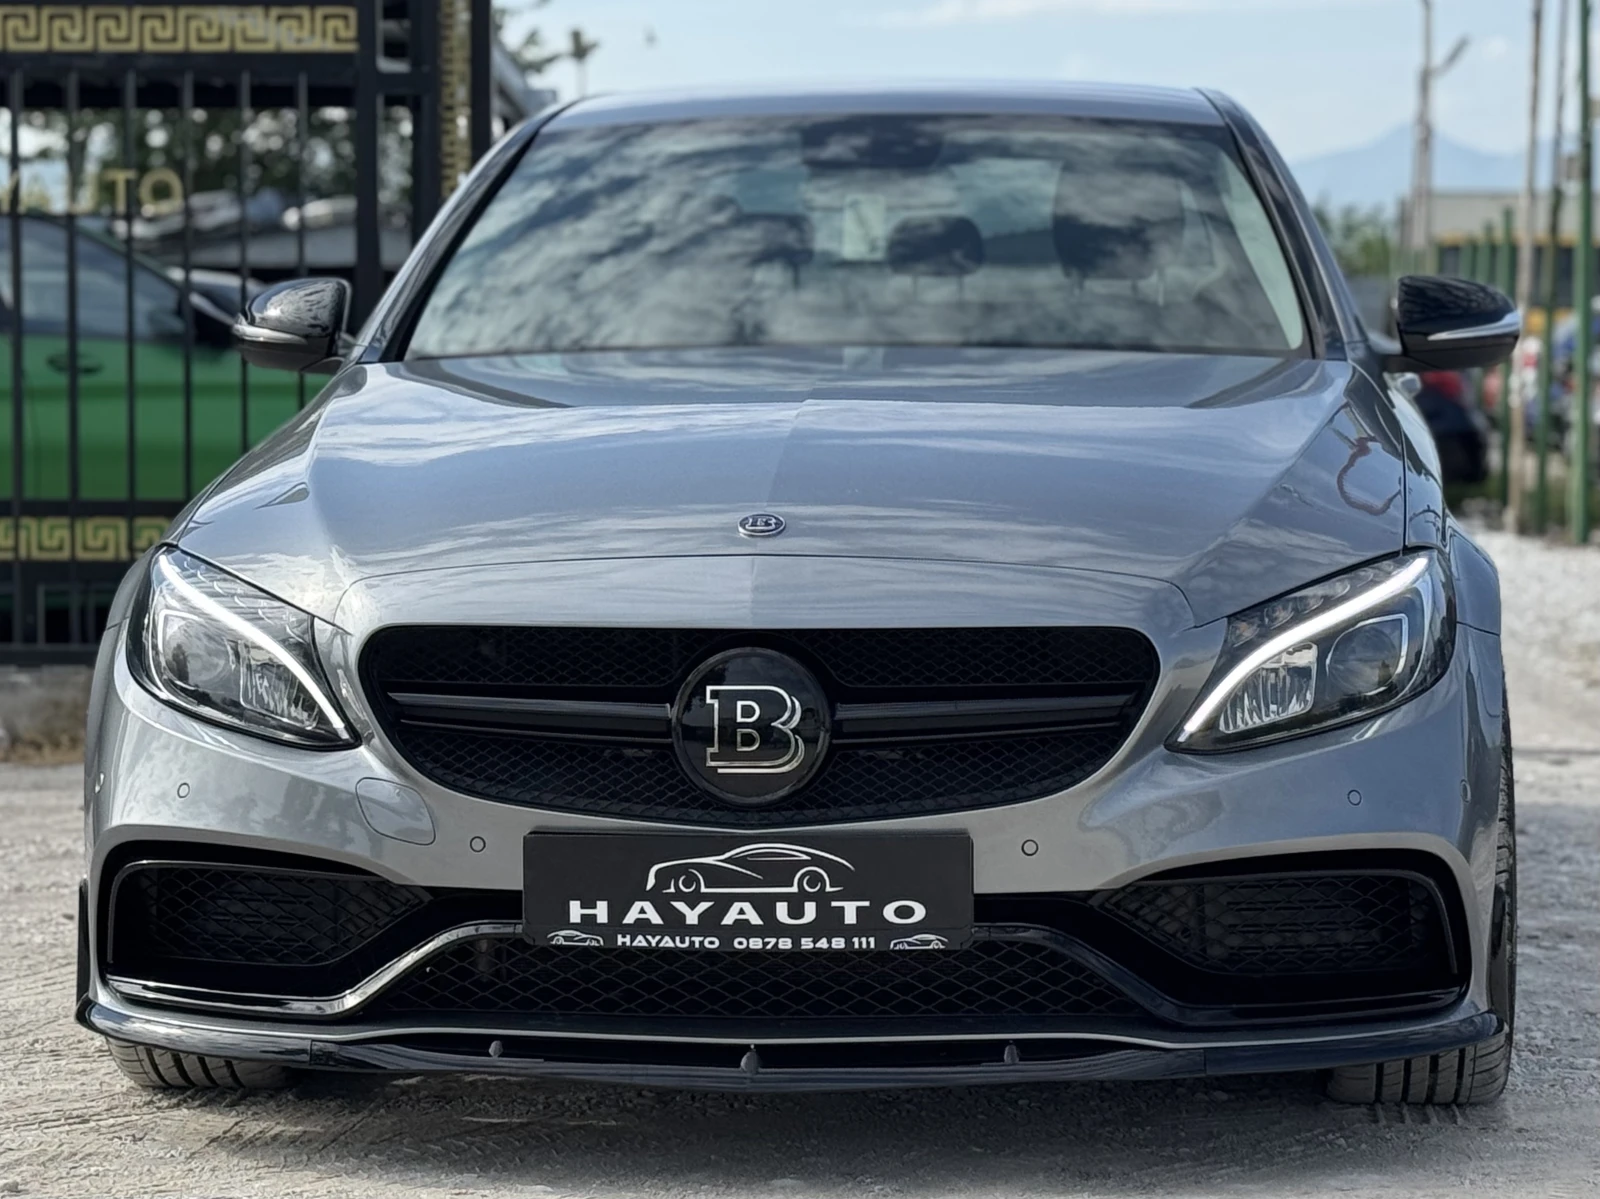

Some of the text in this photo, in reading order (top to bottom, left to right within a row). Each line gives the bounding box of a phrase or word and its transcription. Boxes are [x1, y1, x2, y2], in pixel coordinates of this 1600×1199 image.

[705, 685, 805, 774] B
[568, 899, 927, 925] HAYAUTO
[617, 933, 875, 950] HAYAUTO 0878 548 111
